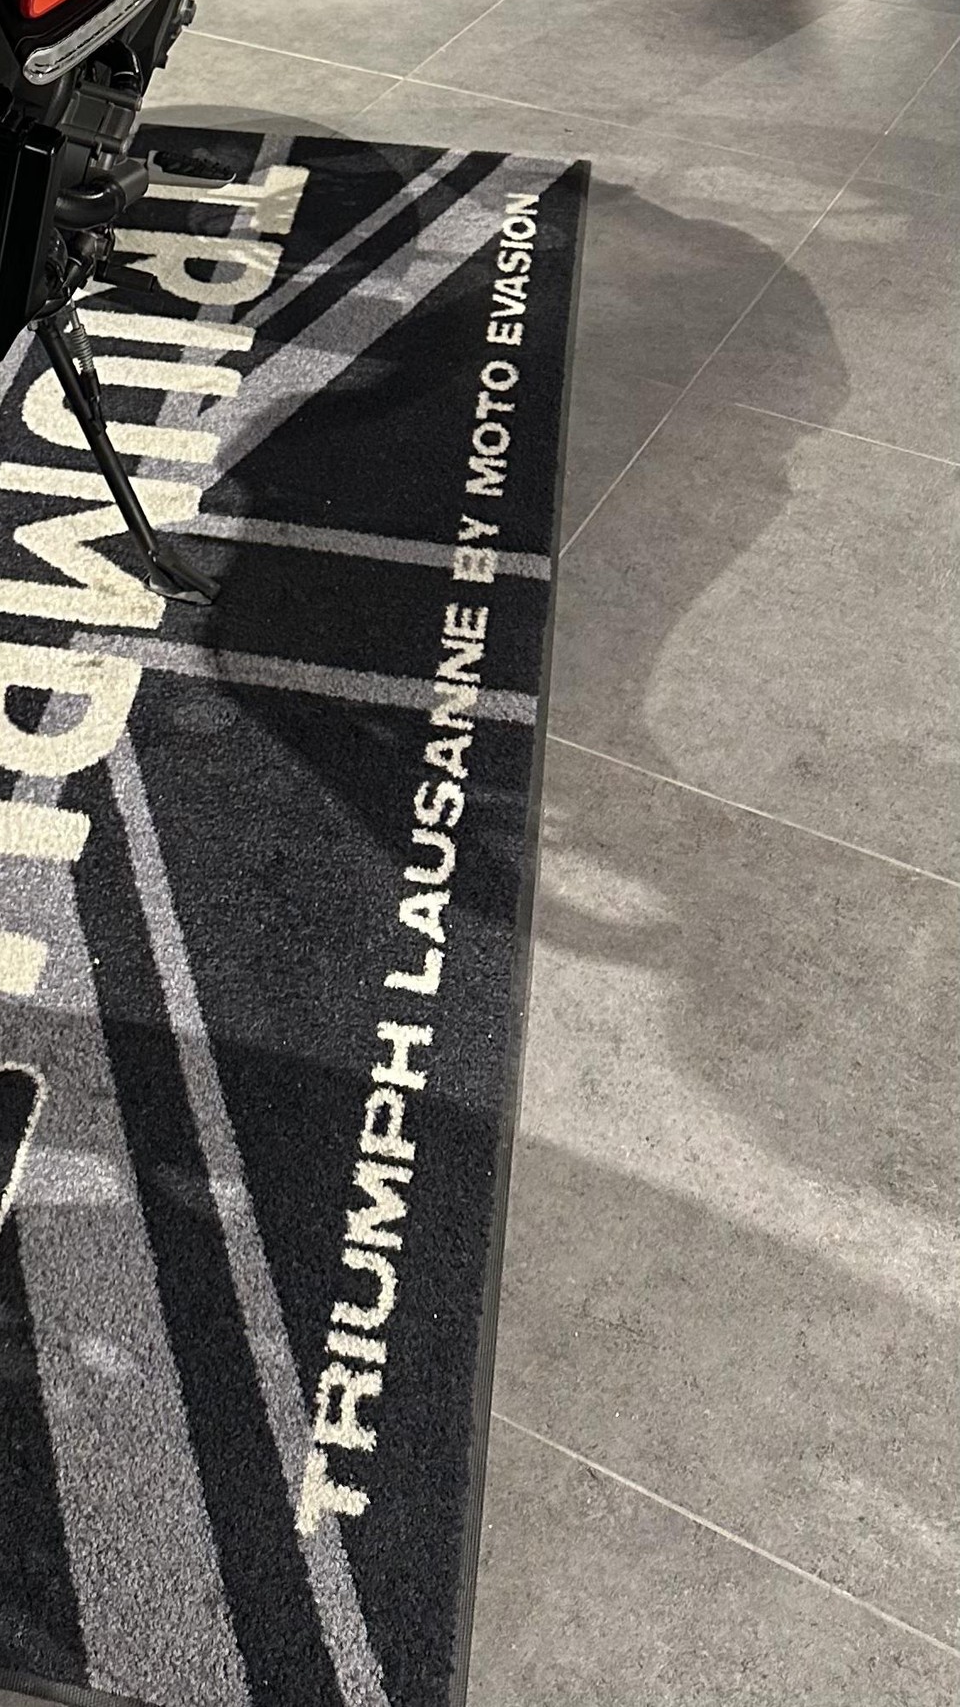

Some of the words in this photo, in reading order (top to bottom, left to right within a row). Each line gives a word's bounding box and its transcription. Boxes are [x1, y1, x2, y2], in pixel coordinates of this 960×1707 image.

[485, 193, 540, 346] EVASION
[465, 359, 520, 497] MOTO
[453, 513, 500, 583] BY
[384, 602, 489, 998] LAUSANNE
[294, 1020, 434, 1537] TRIUMPH
